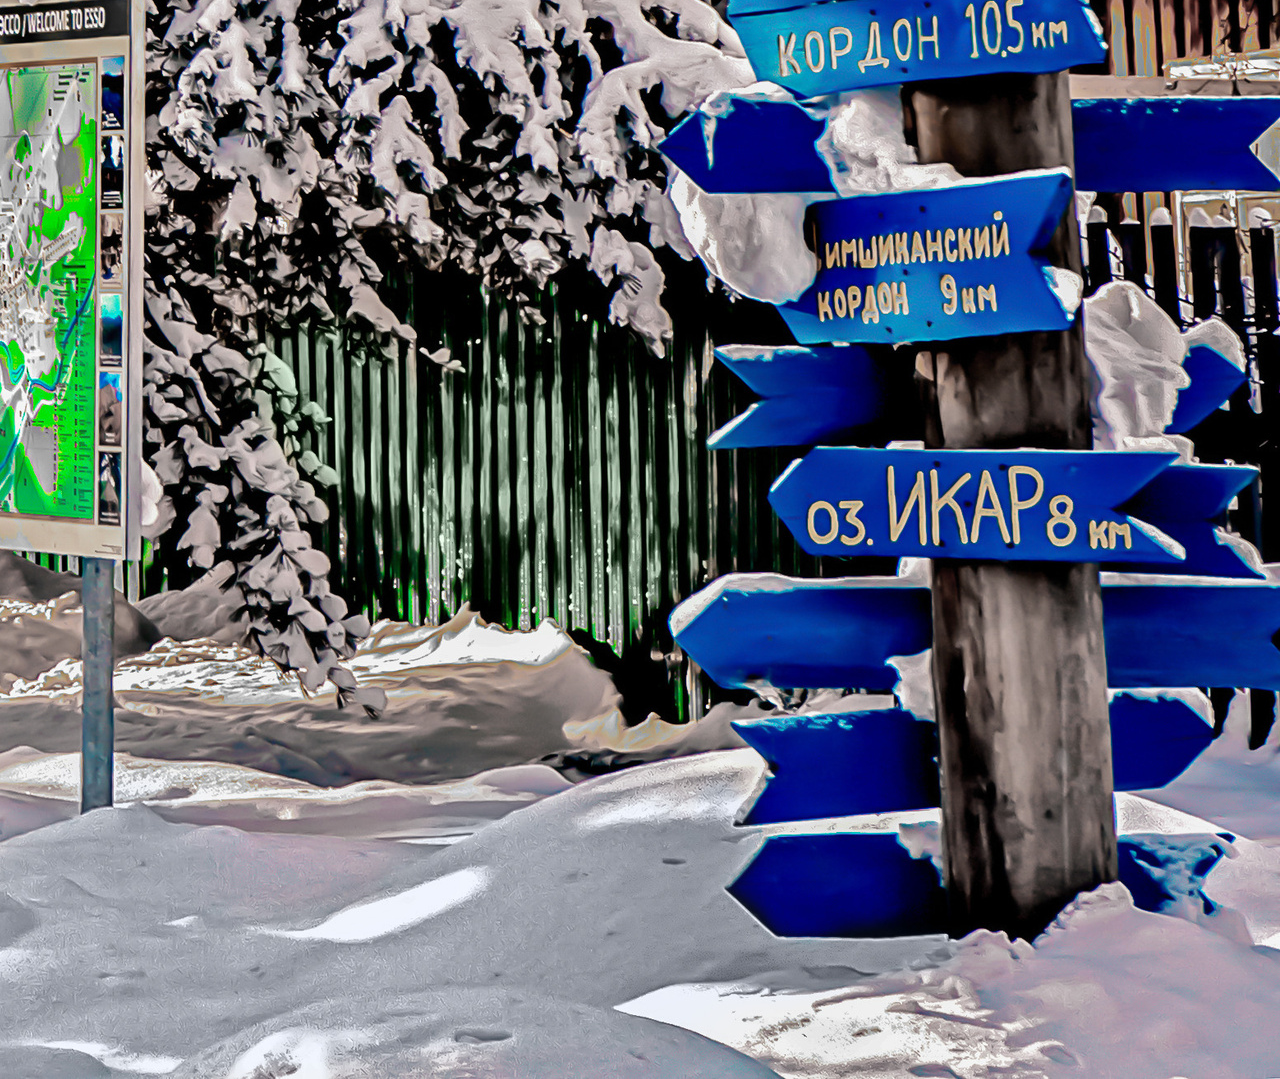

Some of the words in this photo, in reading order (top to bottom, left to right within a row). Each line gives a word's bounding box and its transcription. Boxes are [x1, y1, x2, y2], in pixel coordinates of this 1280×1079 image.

[26, 9, 70, 33] WELCOME
[70, 8, 83, 30] TO
[83, 6, 106, 29] ESSO
[777, 15, 939, 77] КОРДОН
[817, 210, 1010, 271] ИМШИКАНСКИЙ
[817, 281, 910, 325] КОРДОН
[887, 464, 1045, 547] ИКАР
[1046, 494, 1078, 548] 8
